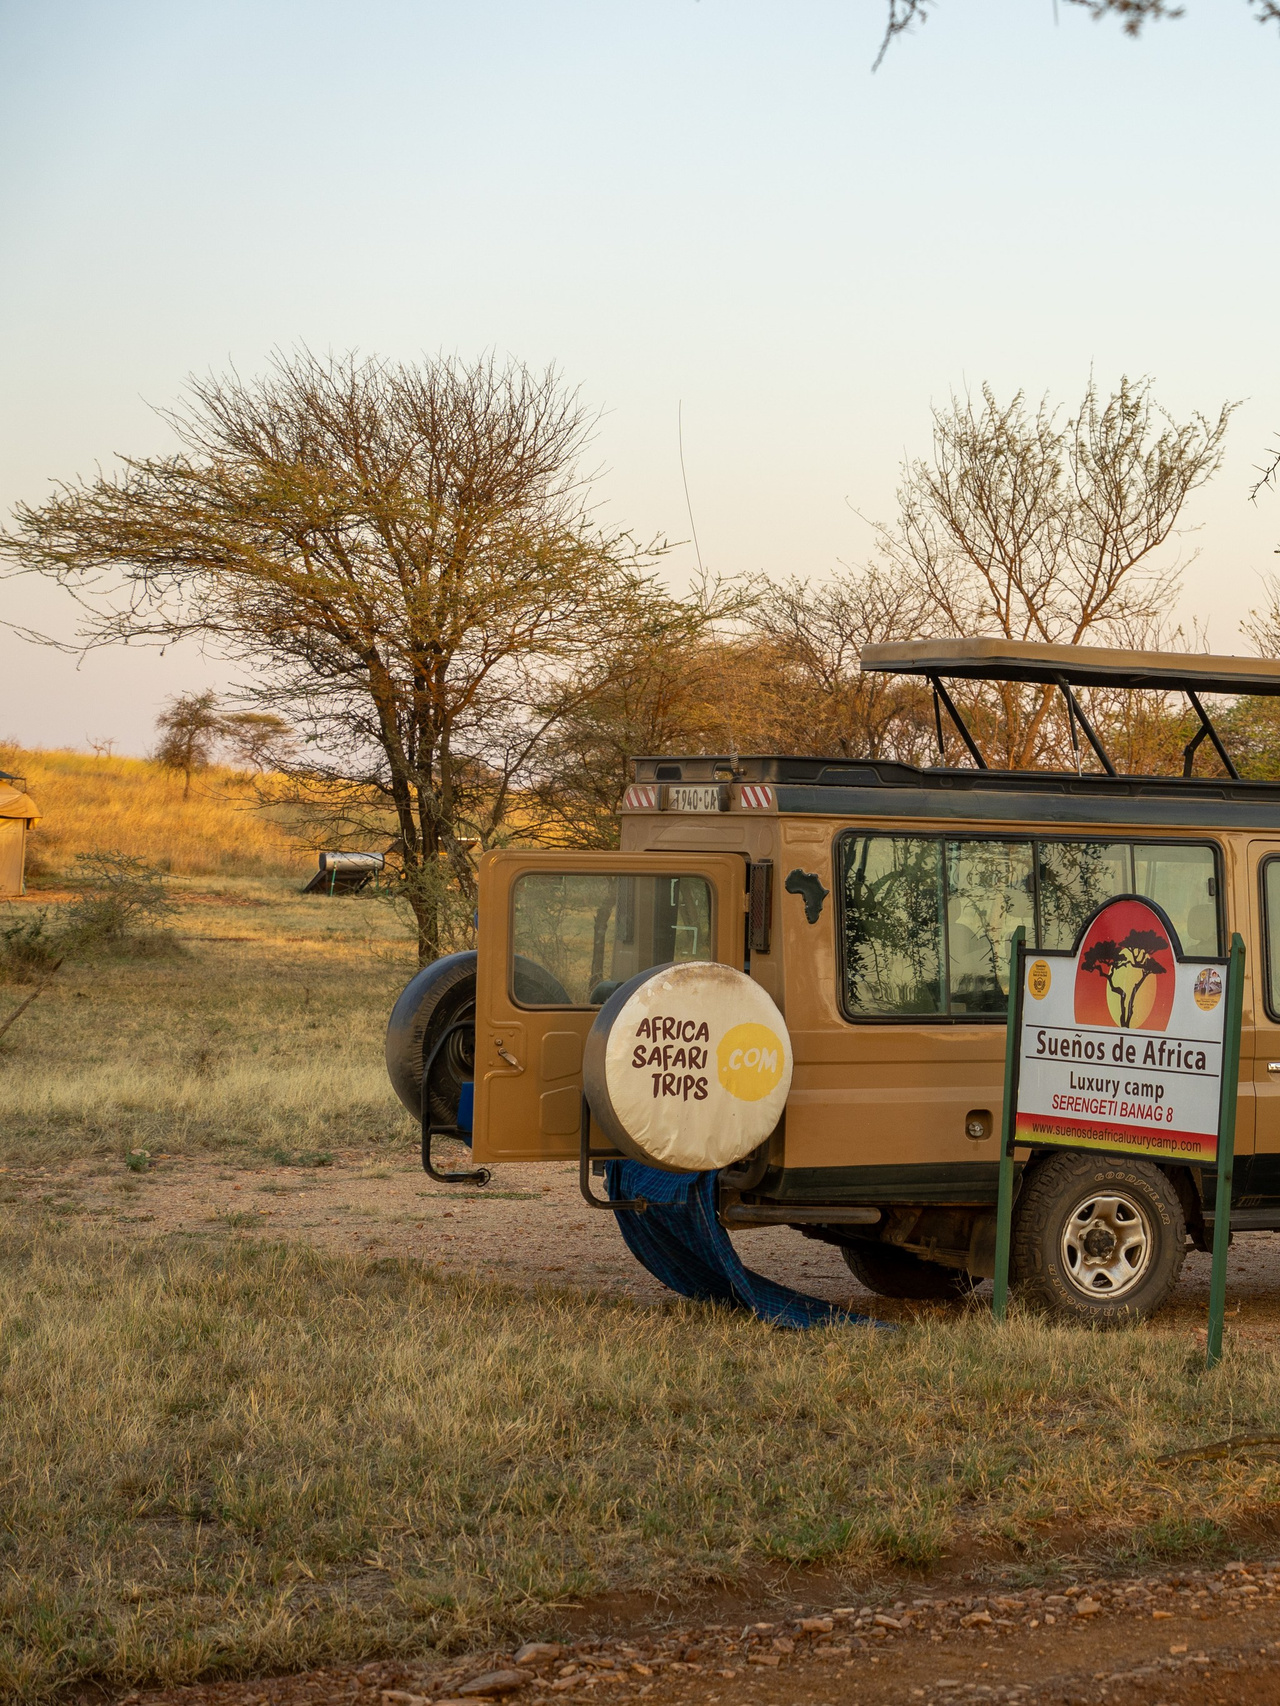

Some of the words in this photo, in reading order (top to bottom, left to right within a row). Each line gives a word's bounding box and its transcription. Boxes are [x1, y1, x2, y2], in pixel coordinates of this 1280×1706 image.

[635, 1016, 710, 1043] AFRICA
[631, 1044, 708, 1071] SAFARI
[722, 1047, 778, 1073] .COM
[1036, 1030, 1105, 1061] Sueños
[1112, 1036, 1136, 1063] de
[1143, 1040, 1206, 1071] Africa
[651, 1073, 709, 1102] TRIPS
[1069, 1071, 1120, 1098] Luxury
[1124, 1080, 1165, 1103] camp
[1051, 1094, 1118, 1116] SERENGETI
[1120, 1102, 1163, 1122] BANAG
[1166, 1107, 1174, 1123] 8
[1032, 1122, 1202, 1152] www.suenosdeafricaluxurycamp.com
[1094, 1171, 1171, 1225] GOODYEAR
